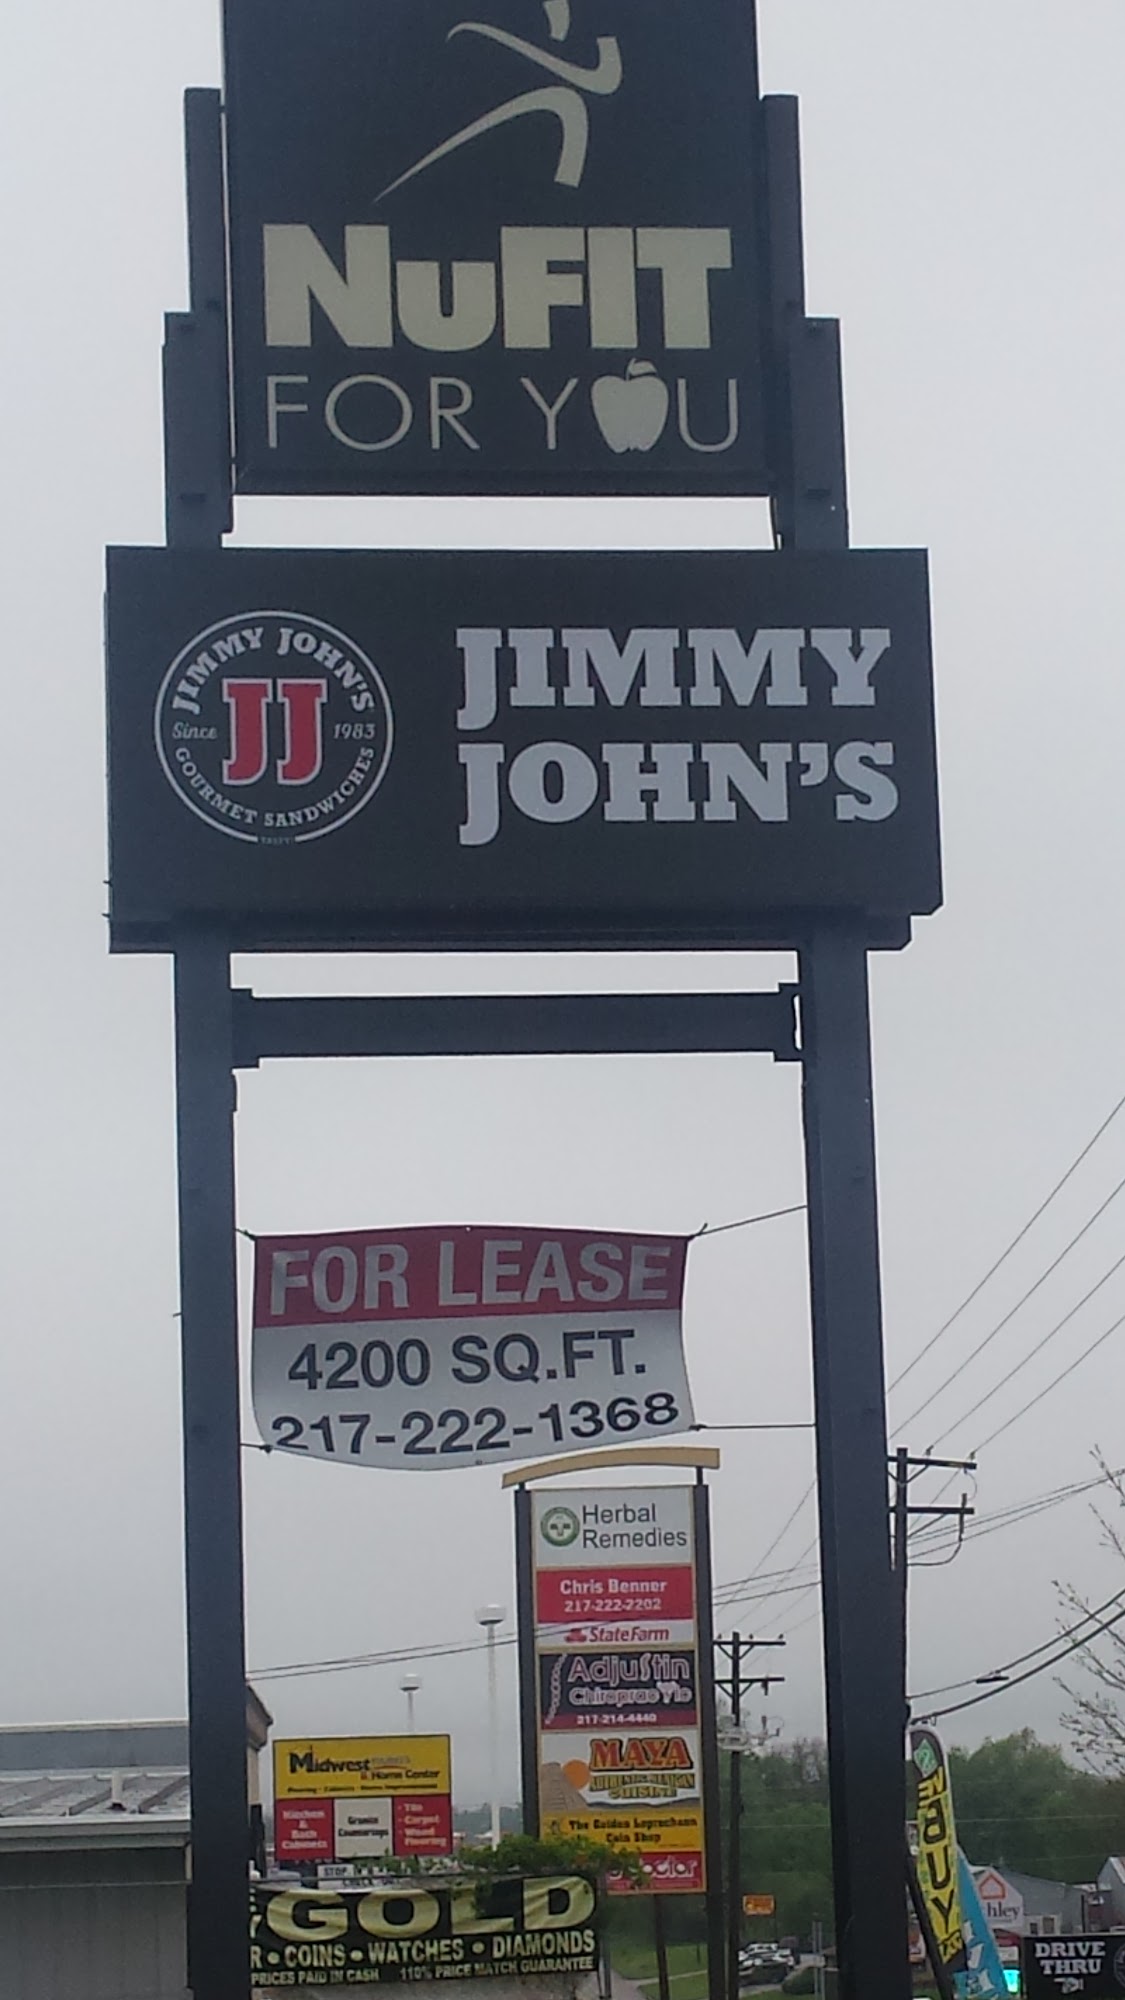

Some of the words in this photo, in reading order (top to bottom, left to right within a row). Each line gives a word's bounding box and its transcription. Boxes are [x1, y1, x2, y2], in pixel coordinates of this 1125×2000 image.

[263, 224, 732, 351] NuFIT
[267, 374, 480, 452] FOR
[172, 626, 264, 715] JIMMY
[276, 627, 376, 713] JOHN'S
[456, 627, 892, 731] JIMMY
[172, 722, 218, 740] Since
[333, 722, 376, 740] 1983
[222, 678, 328, 786] JJ
[175, 747, 258, 825] GOURMET
[263, 746, 375, 828] SANDWICHES
[458, 741, 900, 847] JOHN'S
[270, 1243, 409, 1316] FOR
[437, 1240, 671, 1306] LEASE
[287, 1338, 431, 1391] 4200
[451, 1328, 647, 1384] SQ.FT.
[271, 1391, 679, 1455] 217-222-1368
[582, 1503, 656, 1524] Herbal
[582, 1527, 687, 1549] Remedies
[560, 1579, 603, 1595] Chris
[608, 1578, 667, 1594] Benner
[289, 1747, 371, 1774] Midwest
[590, 1737, 693, 1770] MAYA
[569, 1820, 589, 1831] The
[266, 1876, 596, 1942] GOLD
[986, 1901, 1021, 1920] hley
[284, 1943, 346, 1968] COINS
[368, 1939, 465, 1965] WATCHES
[492, 1929, 596, 1960] DIAMONDS
[1034, 1941, 1106, 1958] DRIVE
[1040, 1958, 1102, 1975] THRU
[251, 1971, 295, 1986] PRICES
[298, 1970, 327, 1984] PAID
[346, 1968, 380, 1982] CASH
[400, 1965, 433, 1981] 110%
[435, 1963, 472, 1979] PRICE
[474, 1961, 517, 1977] MATCH
[520, 1956, 594, 1974] GUARANTEE
